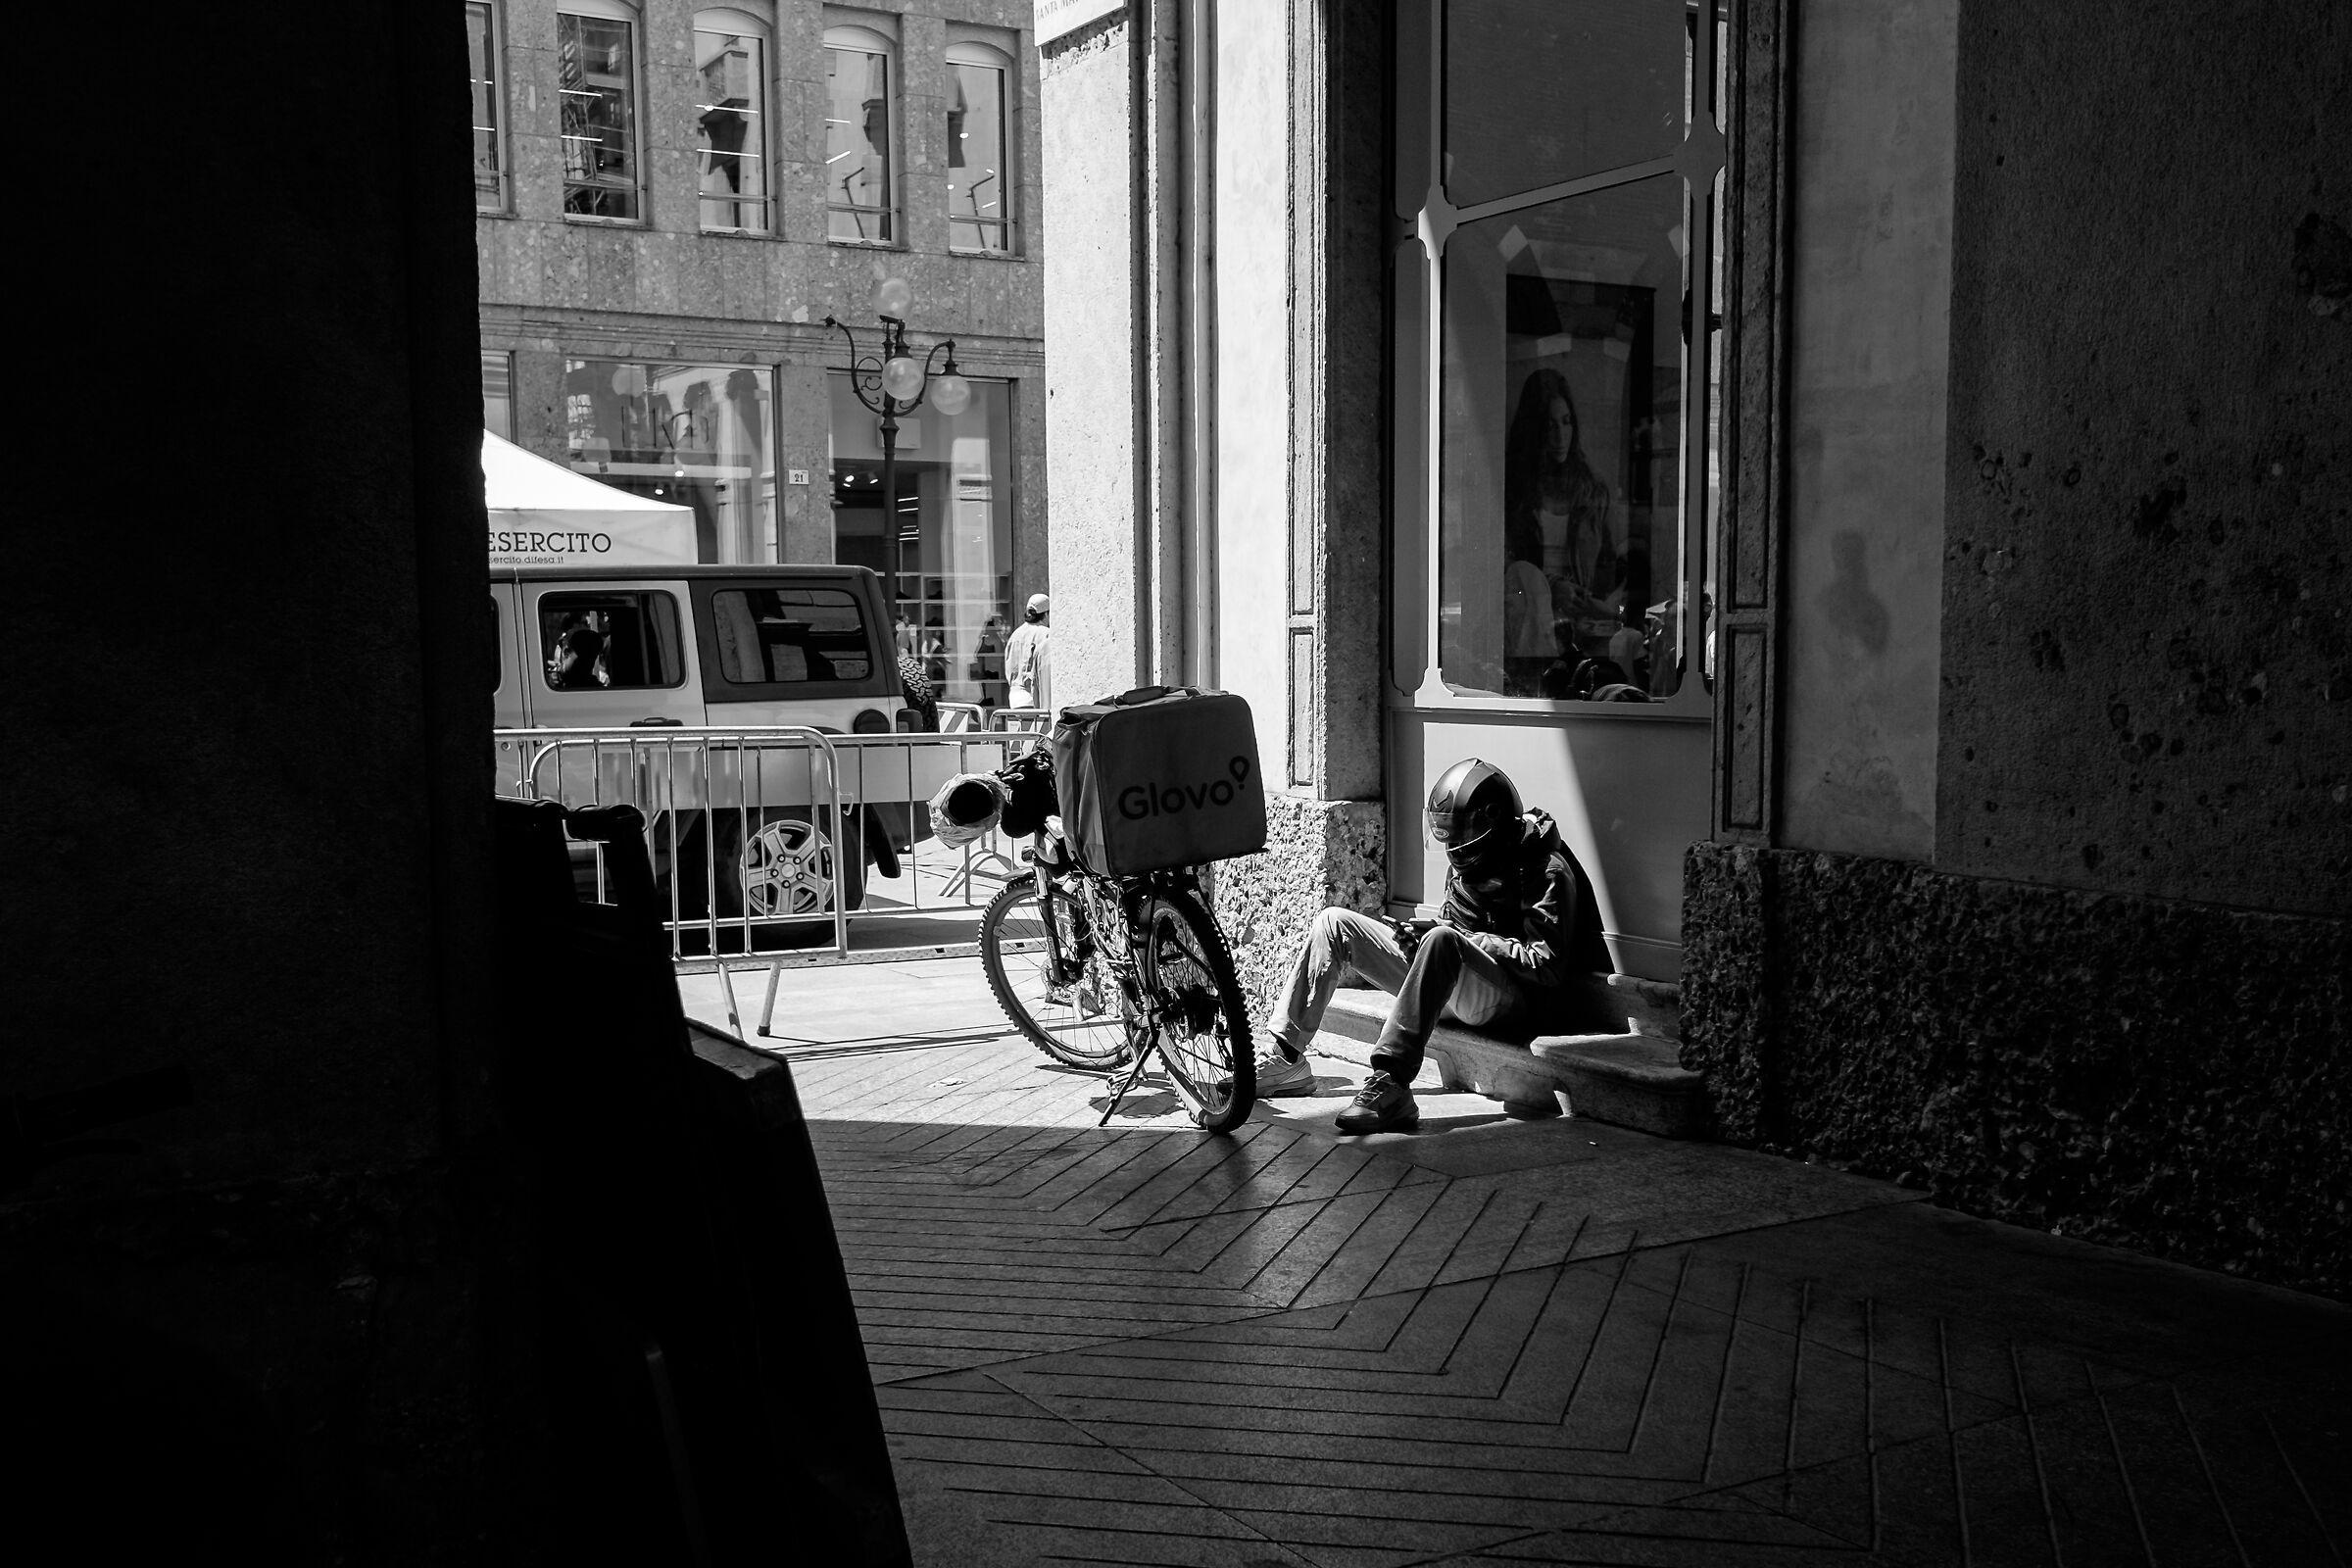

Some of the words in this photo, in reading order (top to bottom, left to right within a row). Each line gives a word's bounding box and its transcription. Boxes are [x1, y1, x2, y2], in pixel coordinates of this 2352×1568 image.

[1036, 1, 1058, 21] SANTA
[794, 473, 804, 482] 21
[1118, 780, 1235, 820] Glovo
